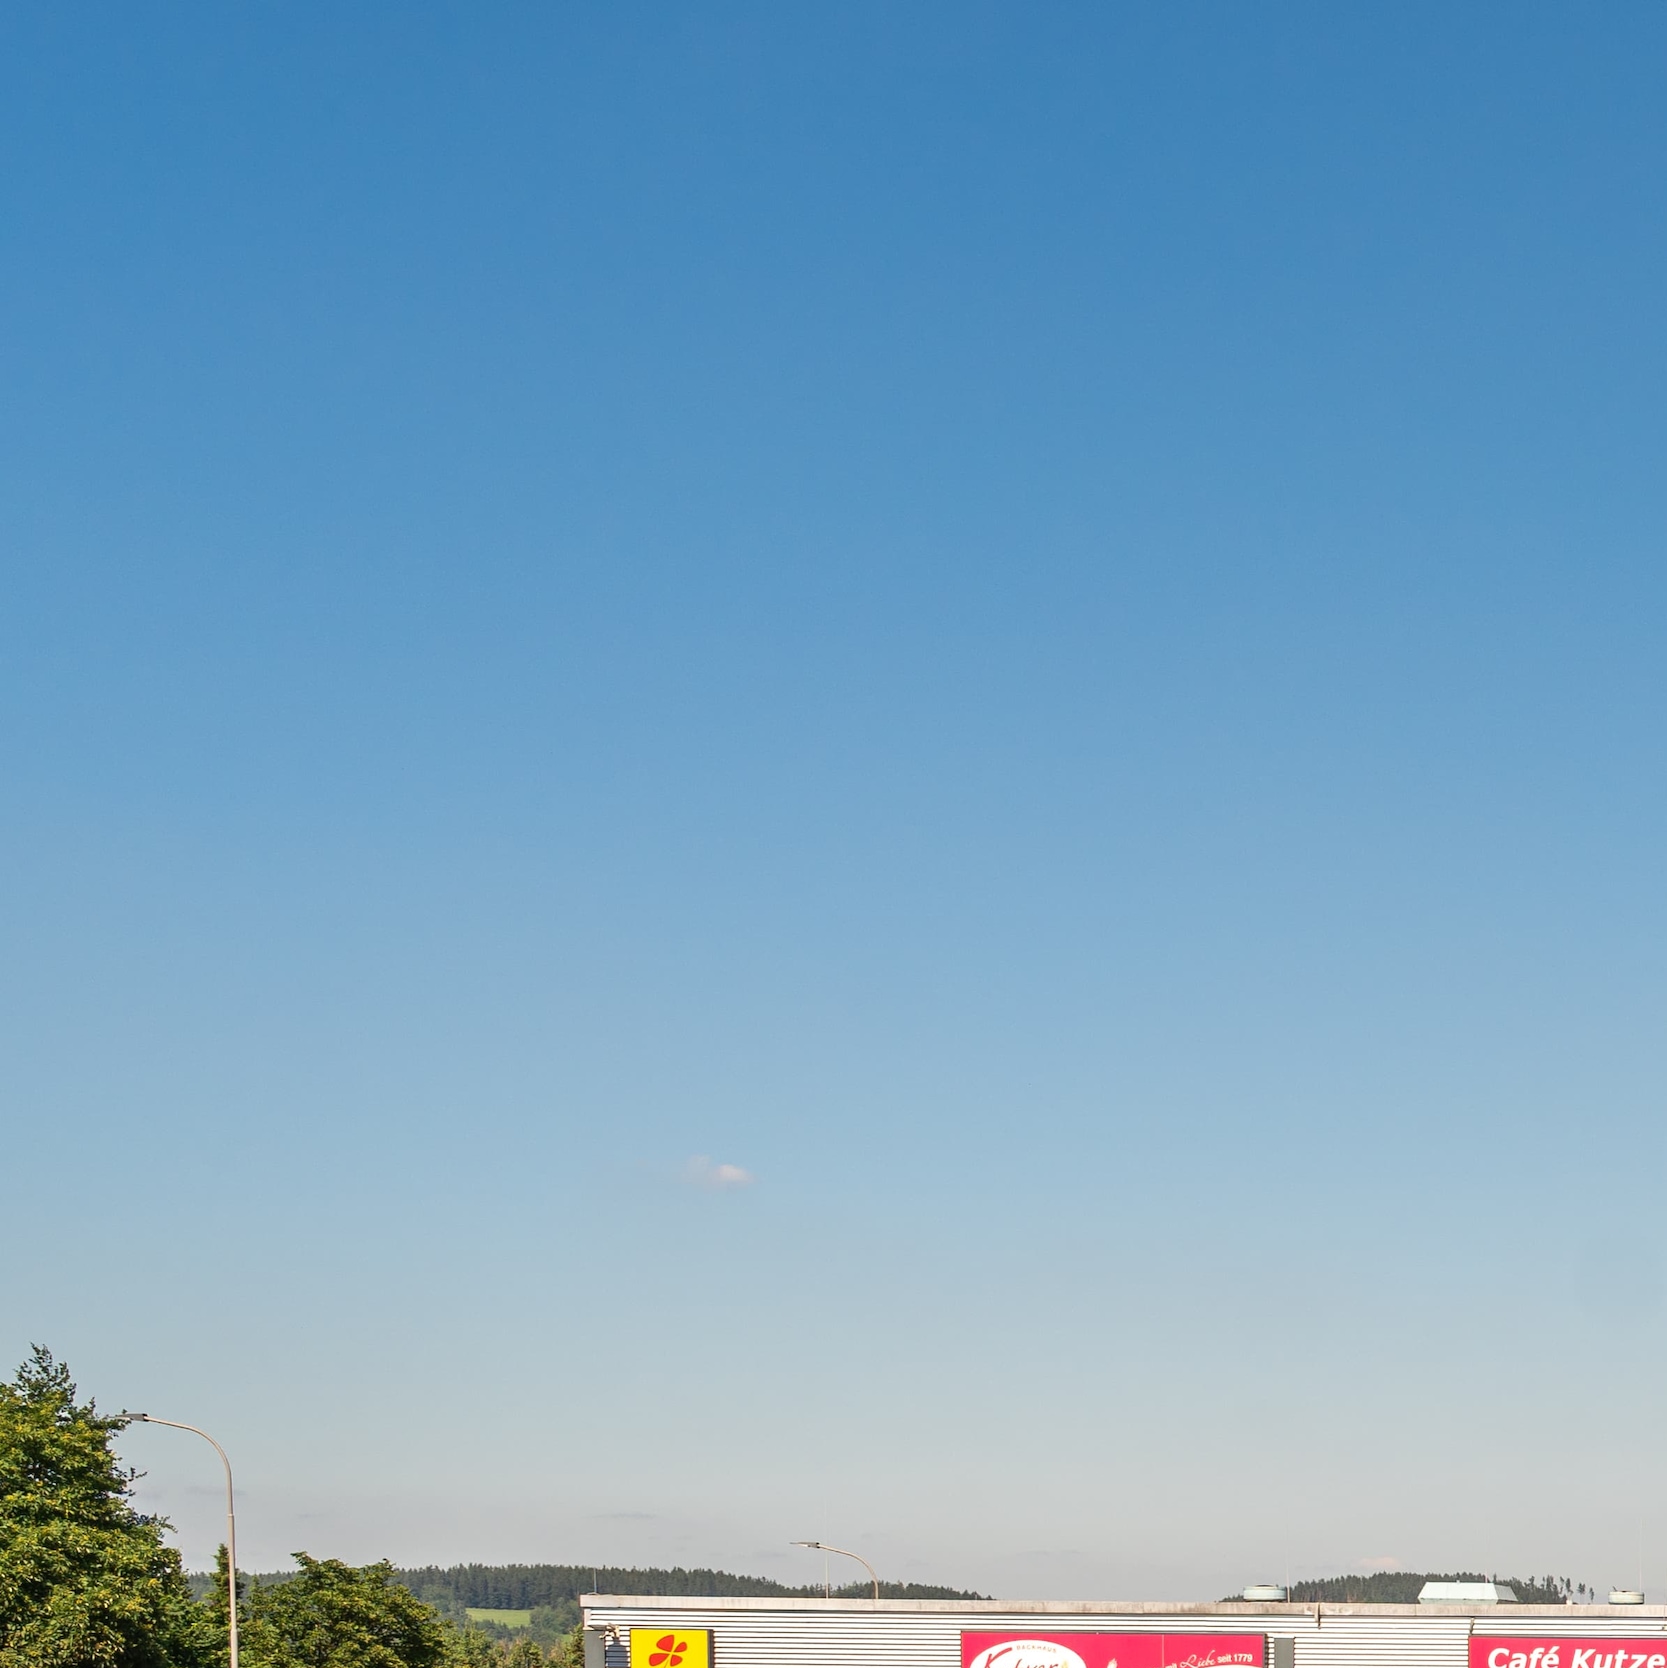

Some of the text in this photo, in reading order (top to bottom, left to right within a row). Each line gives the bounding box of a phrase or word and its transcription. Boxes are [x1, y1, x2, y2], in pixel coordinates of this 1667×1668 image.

[1016, 1645, 1057, 1653] BACKHAUS
[1180, 1649, 1216, 1668] Liebe
[1217, 1654, 1232, 1663] seit
[1233, 1653, 1253, 1663] 1779
